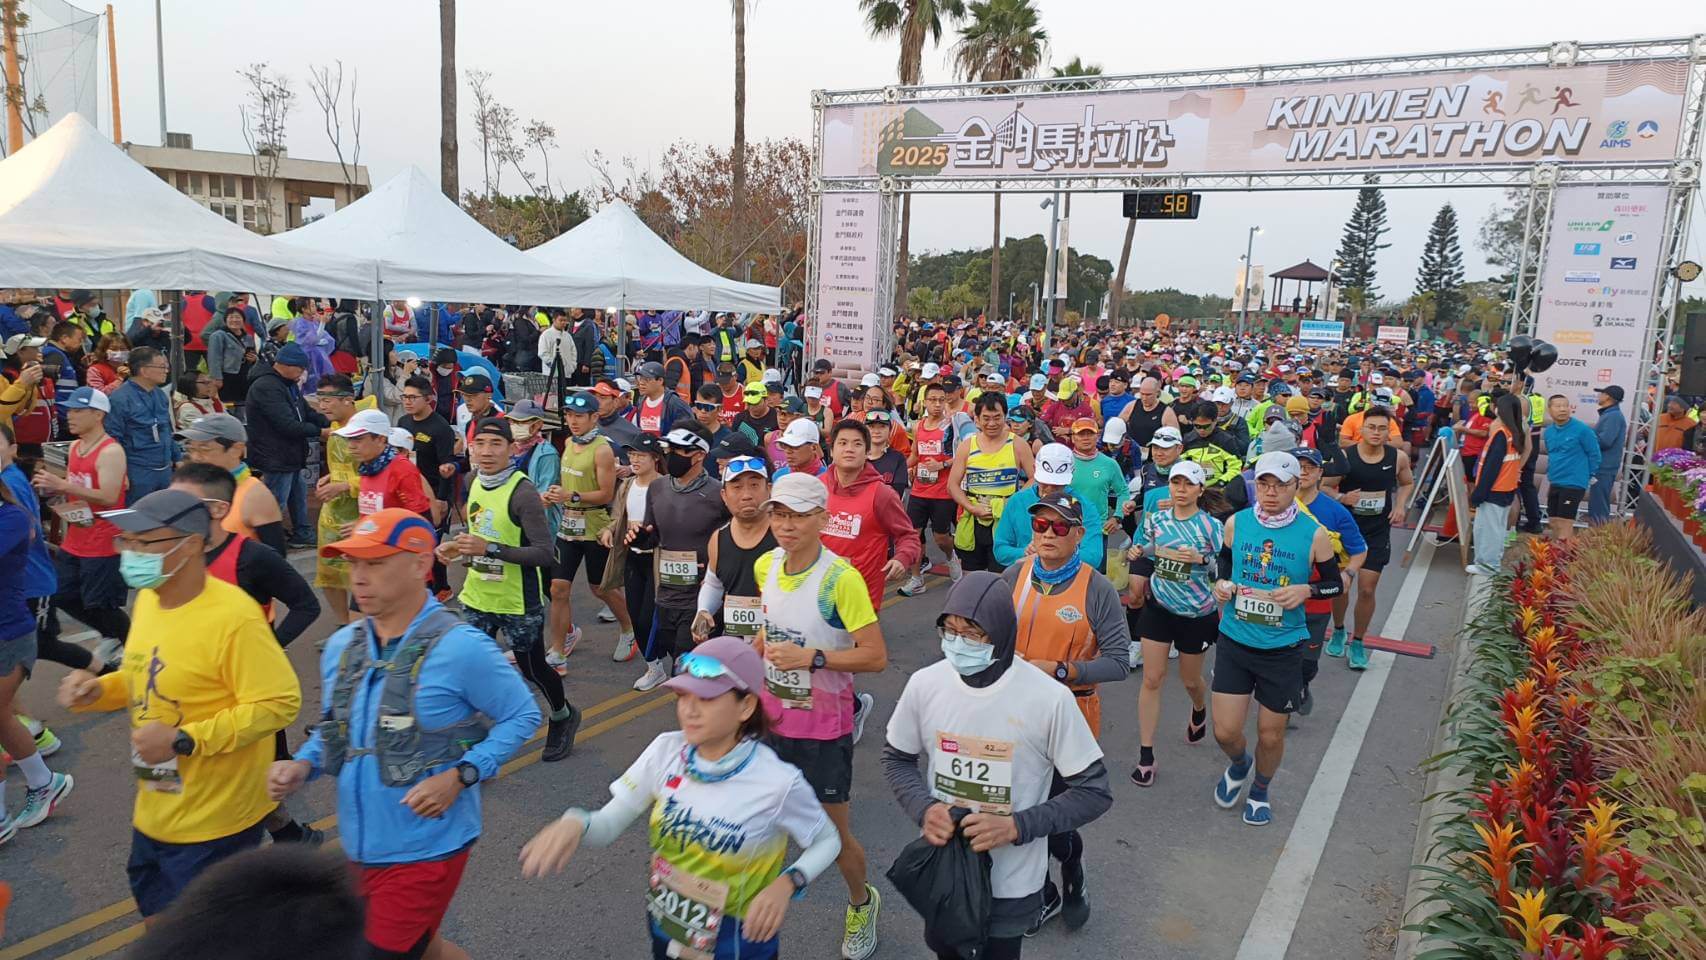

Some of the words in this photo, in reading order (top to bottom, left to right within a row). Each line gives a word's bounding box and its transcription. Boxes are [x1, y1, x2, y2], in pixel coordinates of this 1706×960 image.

[1267, 85, 1469, 130] KINMEN
[890, 145, 949, 167] 2025
[938, 104, 1177, 171] 金門馬拉松
[1286, 117, 1591, 162] MARATHON
[1600, 139, 1632, 149] AIMS
[1582, 348, 1617, 357] everrich
[664, 562, 690, 574] 1138
[1158, 557, 1185, 572] 2177
[1243, 600, 1274, 614] 1160
[732, 610, 755, 623] 660
[951, 757, 989, 782] 612
[654, 883, 708, 930] 2012
